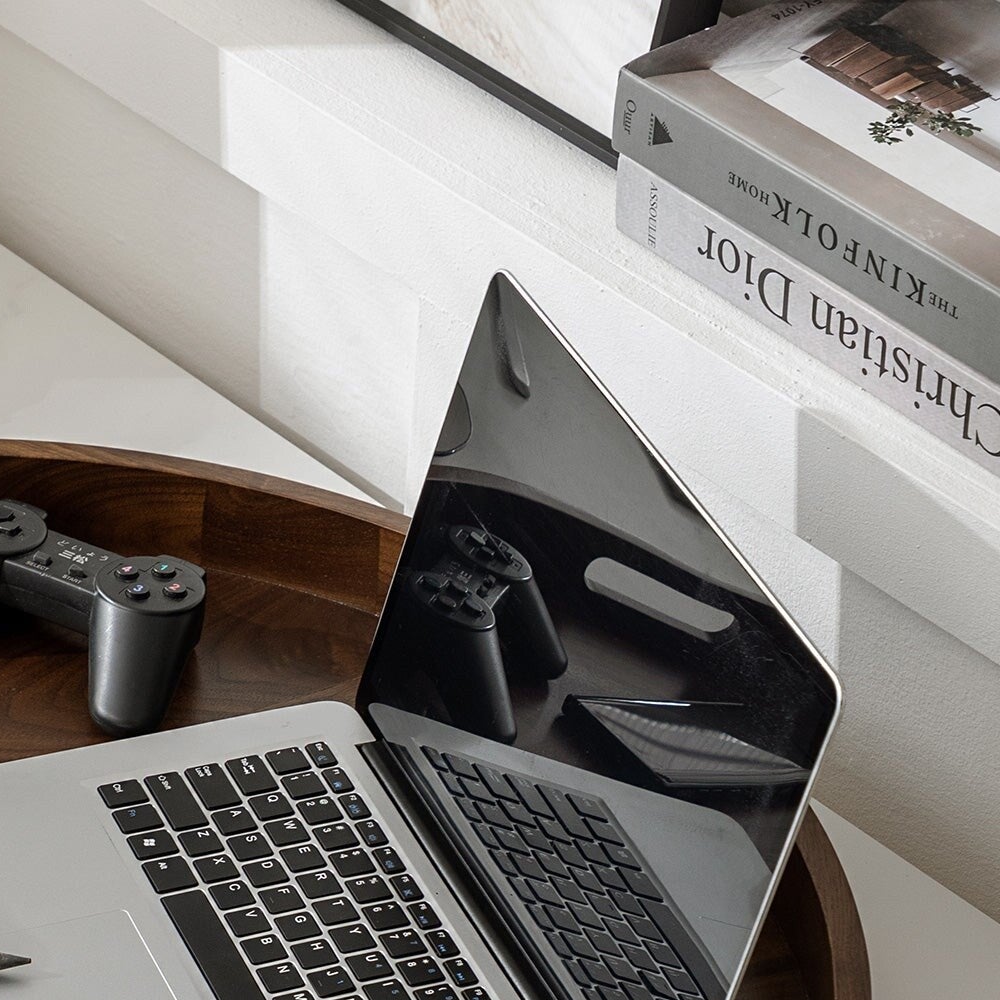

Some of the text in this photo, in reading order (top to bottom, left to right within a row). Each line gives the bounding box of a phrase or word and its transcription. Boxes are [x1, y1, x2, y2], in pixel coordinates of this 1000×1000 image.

[728, 171, 959, 319] THE KINFOLK HOME
[697, 225, 1000, 457] Christian Dior
[25, 560, 50, 571] SELECT
[121, 565, 133, 573] 4
[62, 574, 82, 584] START
[133, 584, 144, 592] 3
[168, 583, 181, 591] 2
[266, 794, 279, 803] Q
[229, 810, 242, 818] A
[283, 820, 298, 830] W
[197, 830, 210, 838] Z
[245, 835, 258, 843] S
[298, 846, 312, 854] E
[212, 856, 226, 865] X
[261, 860, 274, 869] D
[314, 872, 328, 881] R
[228, 883, 241, 892] C
[245, 909, 258, 917] V
[294, 915, 307, 924] G
[349, 926, 362, 934] Y
[260, 936, 273, 945] B
[310, 941, 324, 951] H
[365, 954, 379, 962] U
[276, 964, 291, 974] N
